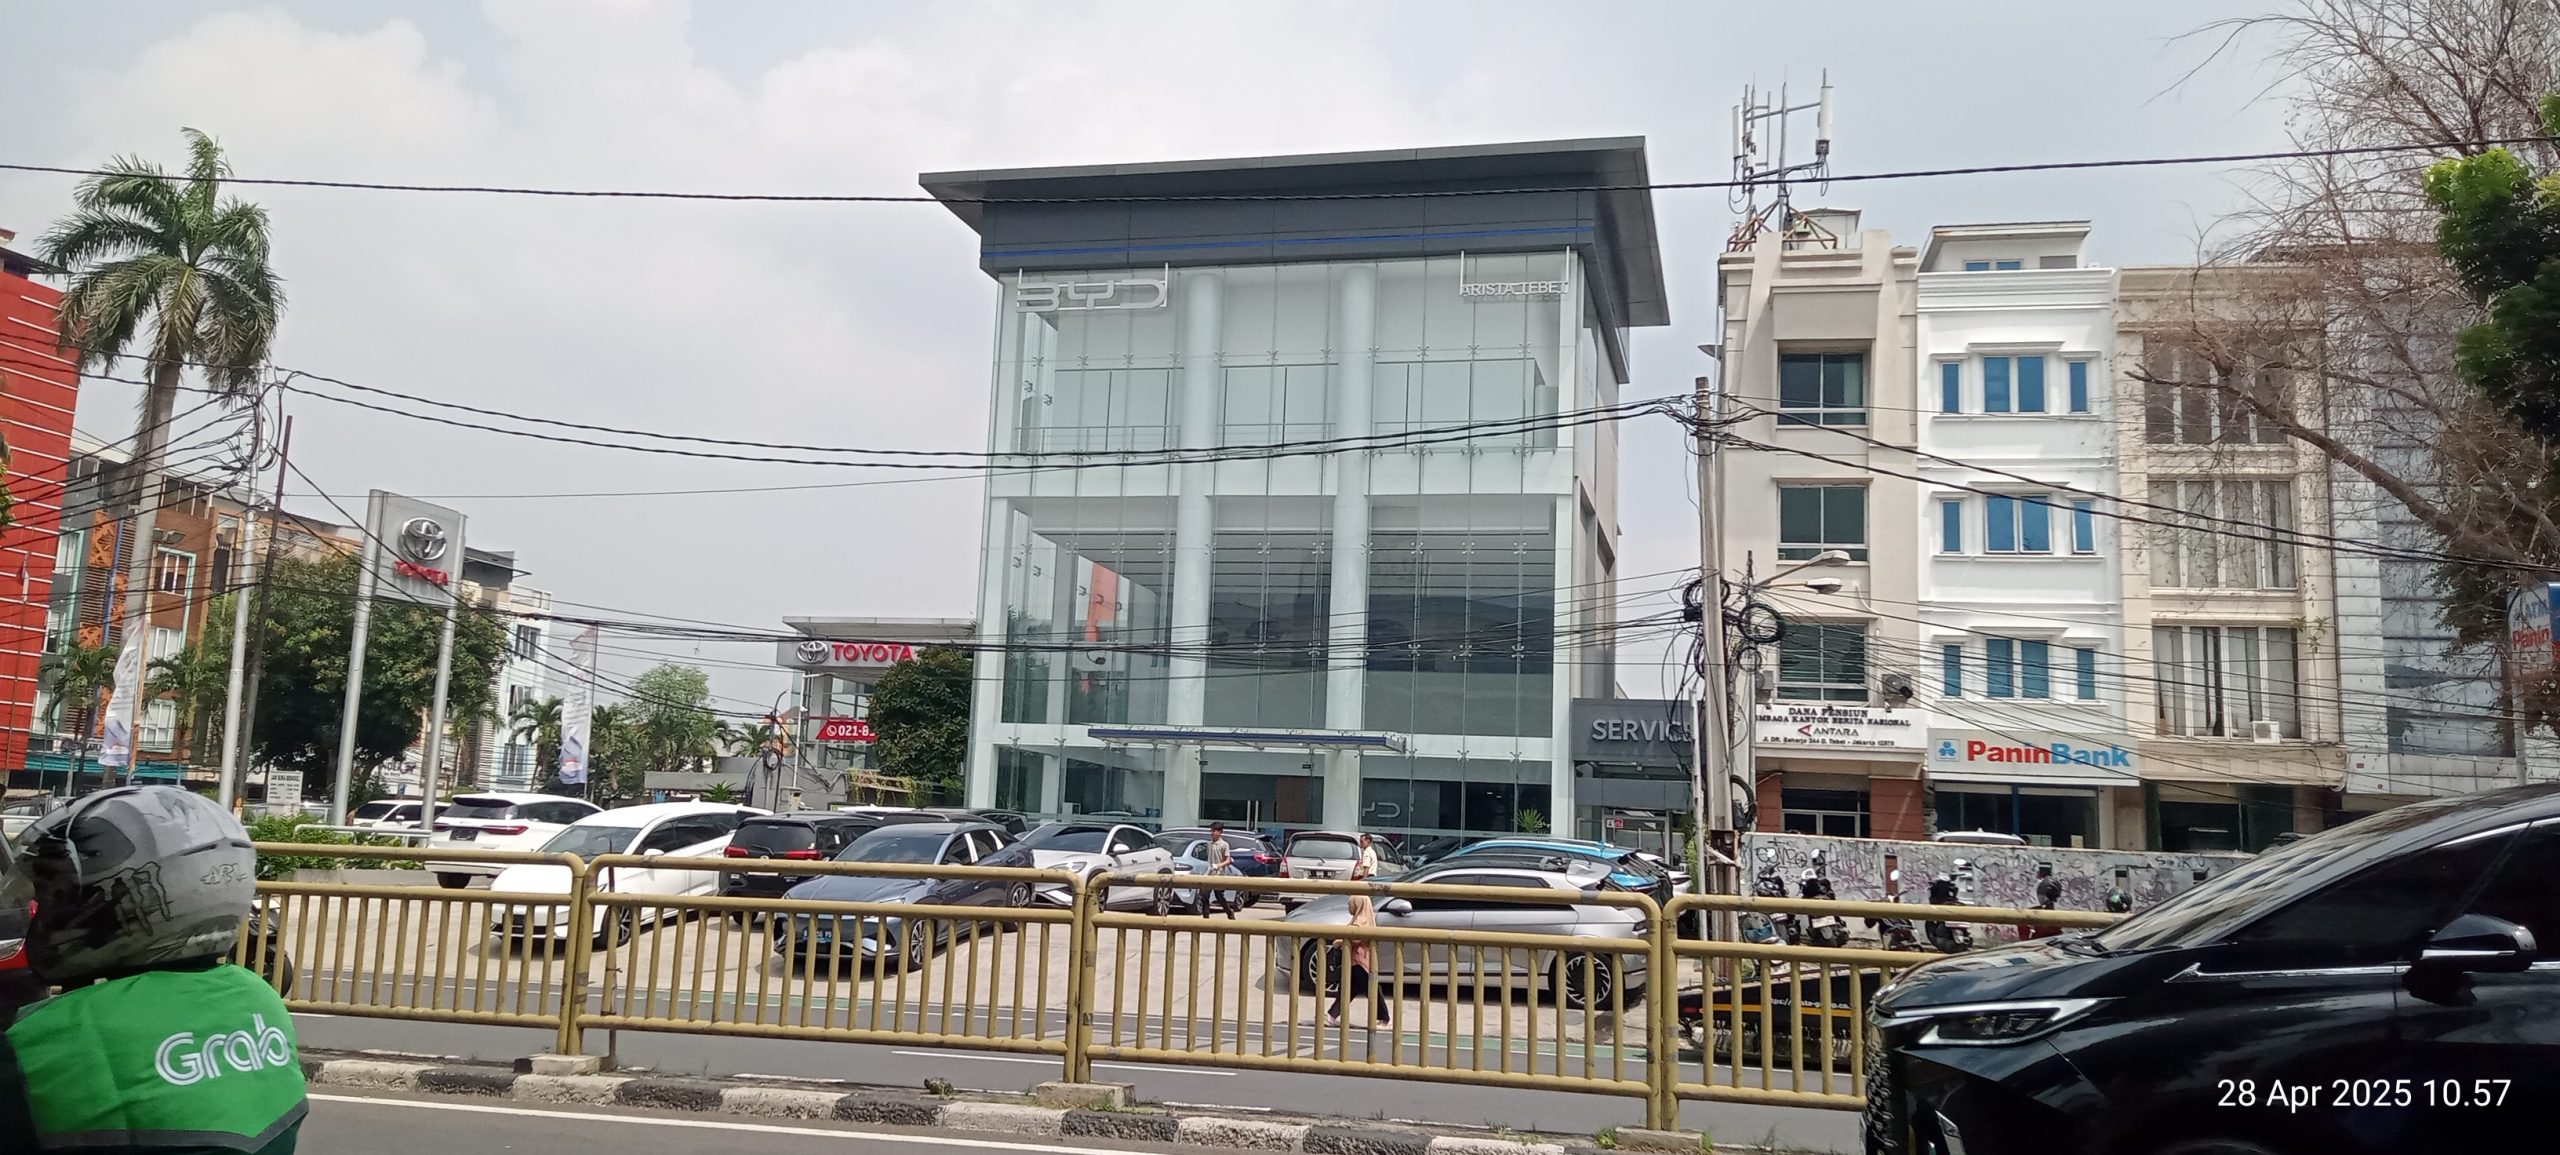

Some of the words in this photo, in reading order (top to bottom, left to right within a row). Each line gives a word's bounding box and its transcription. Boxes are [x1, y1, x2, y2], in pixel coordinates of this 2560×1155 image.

[1016, 278, 1166, 313] BYD
[1461, 282, 1514, 296] ARISTA
[1520, 281, 1569, 295] TEBET
[831, 643, 915, 662] TOYOTA
[1789, 707, 1817, 716] DANA
[1822, 708, 1869, 718] PENSIUN
[1792, 716, 1829, 724] KANTOR
[1832, 717, 1864, 725] BERITA
[1867, 718, 1911, 727] NASIONAL
[838, 725, 876, 737] 021-8
[1813, 727, 1859, 737] ANTARA
[1967, 740, 2131, 767] PaninBank
[155, 1013, 291, 1086] Grab
